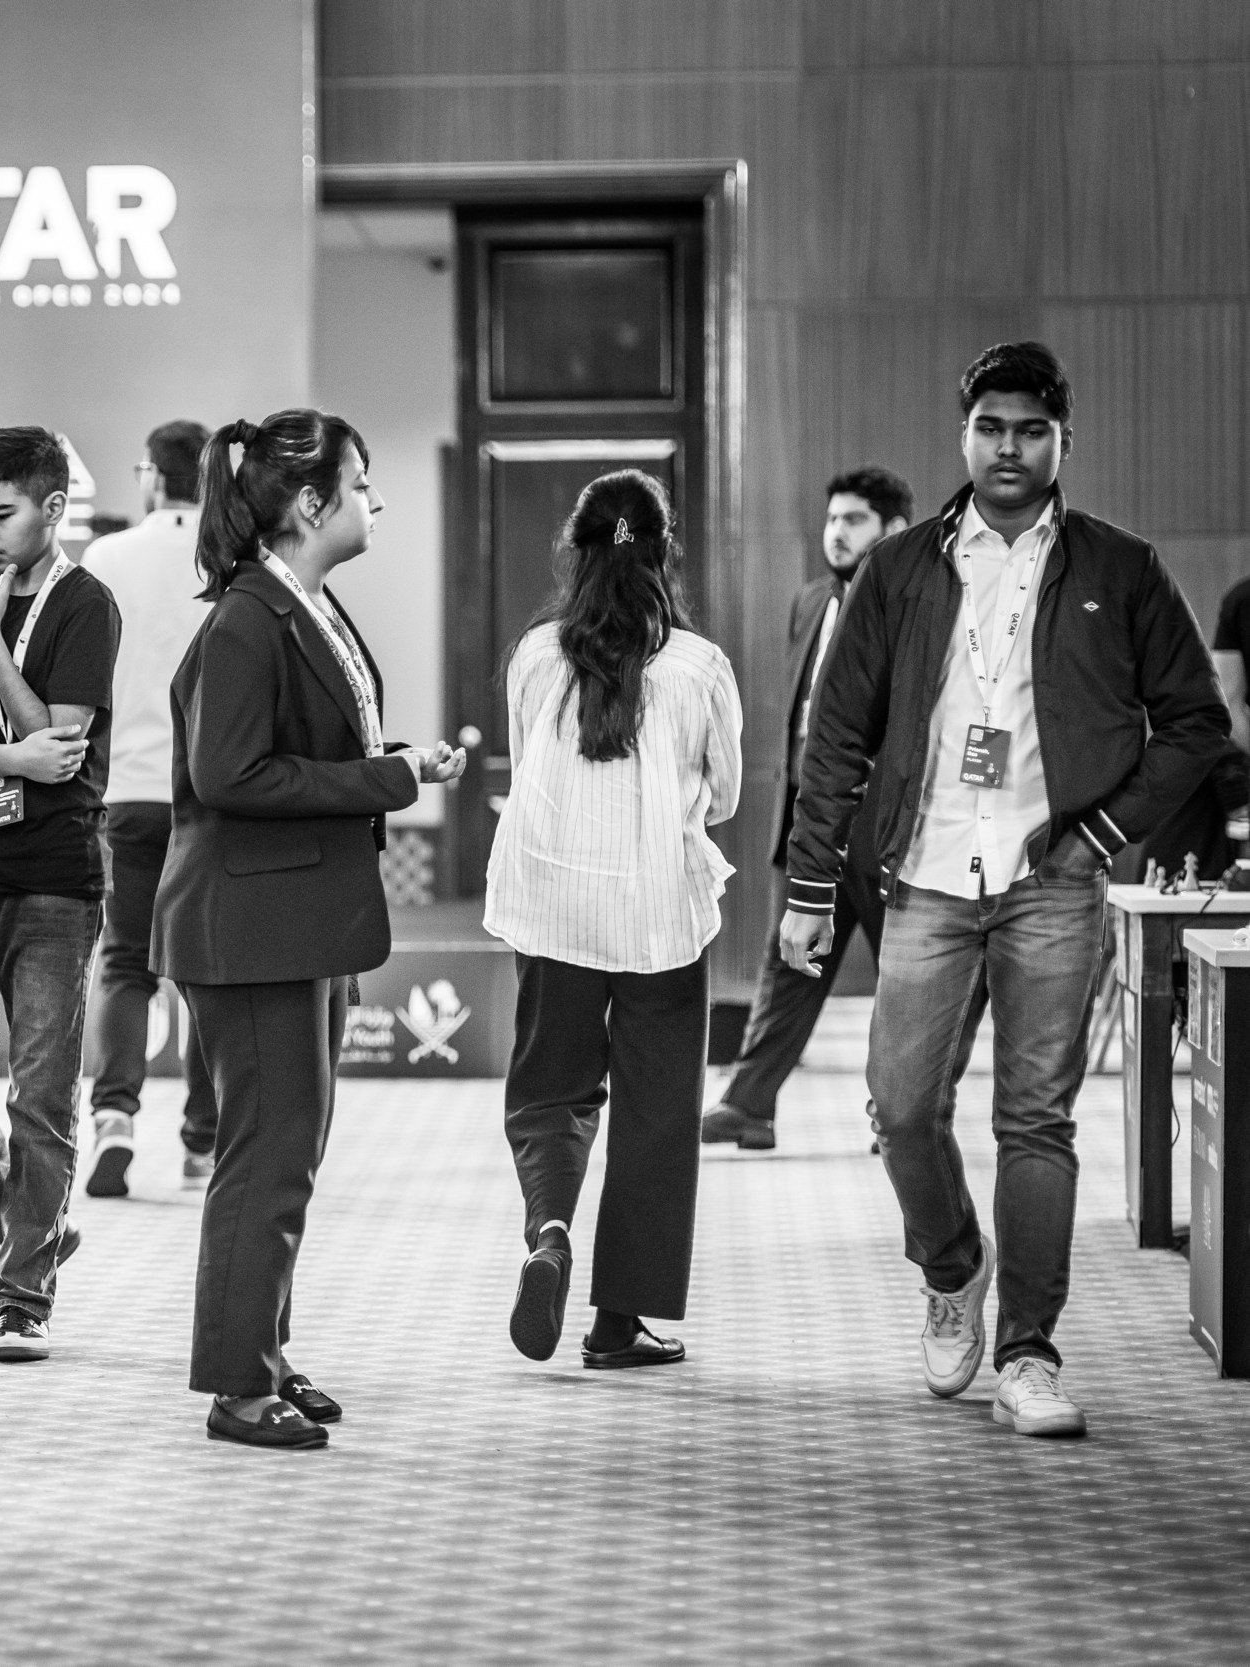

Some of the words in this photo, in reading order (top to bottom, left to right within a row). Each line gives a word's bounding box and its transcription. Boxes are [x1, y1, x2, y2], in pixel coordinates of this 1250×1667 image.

[284, 571, 303, 594] QATAR
[1007, 612, 1020, 637] QATAR
[968, 628, 980, 652] QATAR
[963, 772, 985, 783] QATAR
